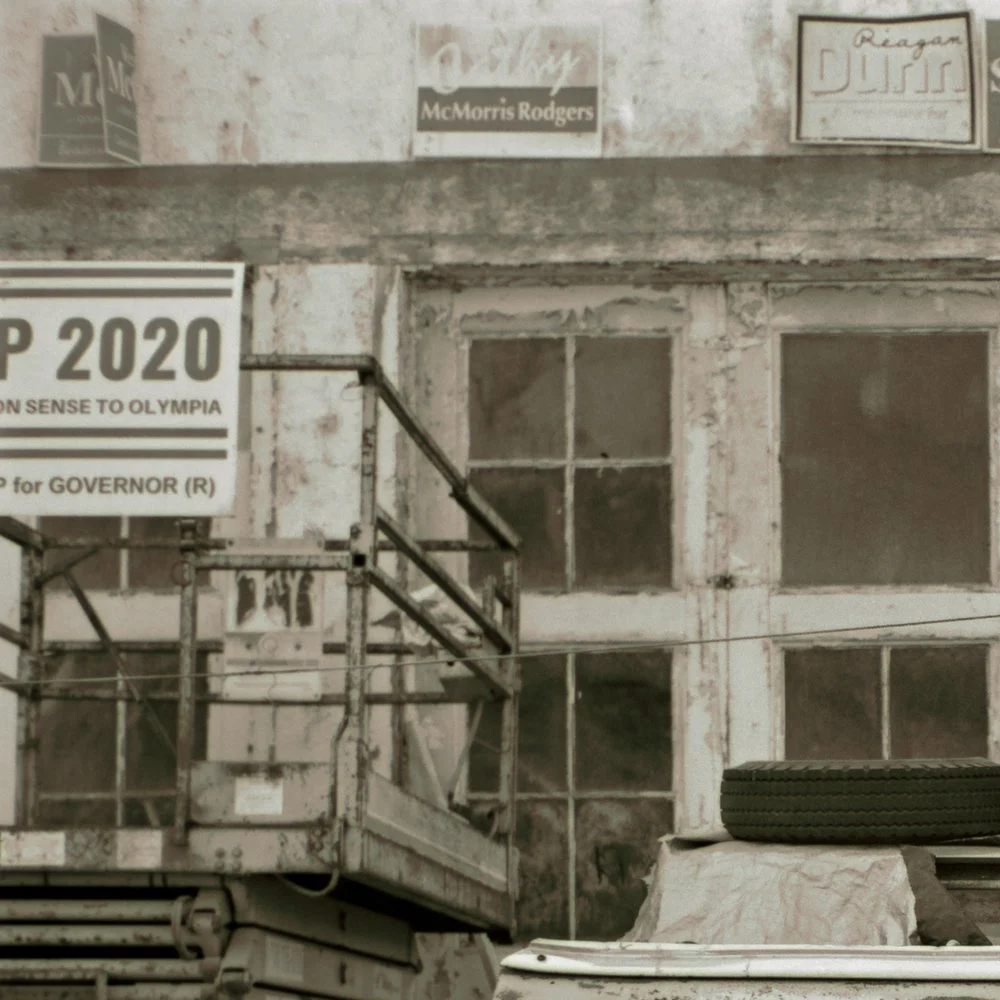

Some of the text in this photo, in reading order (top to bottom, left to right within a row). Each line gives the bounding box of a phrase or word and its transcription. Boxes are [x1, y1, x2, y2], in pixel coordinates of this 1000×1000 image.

[853, 27, 963, 61] Reagan
[810, 47, 968, 96] Dunn
[420, 97, 595, 127] McMorris Rodgers
[56, 316, 222, 382] 2020
[25, 399, 91, 415] SENSE
[96, 399, 124, 415] TO
[128, 399, 223, 415] OLYMPIA
[13, 476, 43, 494] for
[48, 476, 177, 495] GOVERNOR
[185, 477, 216, 498] (R)
